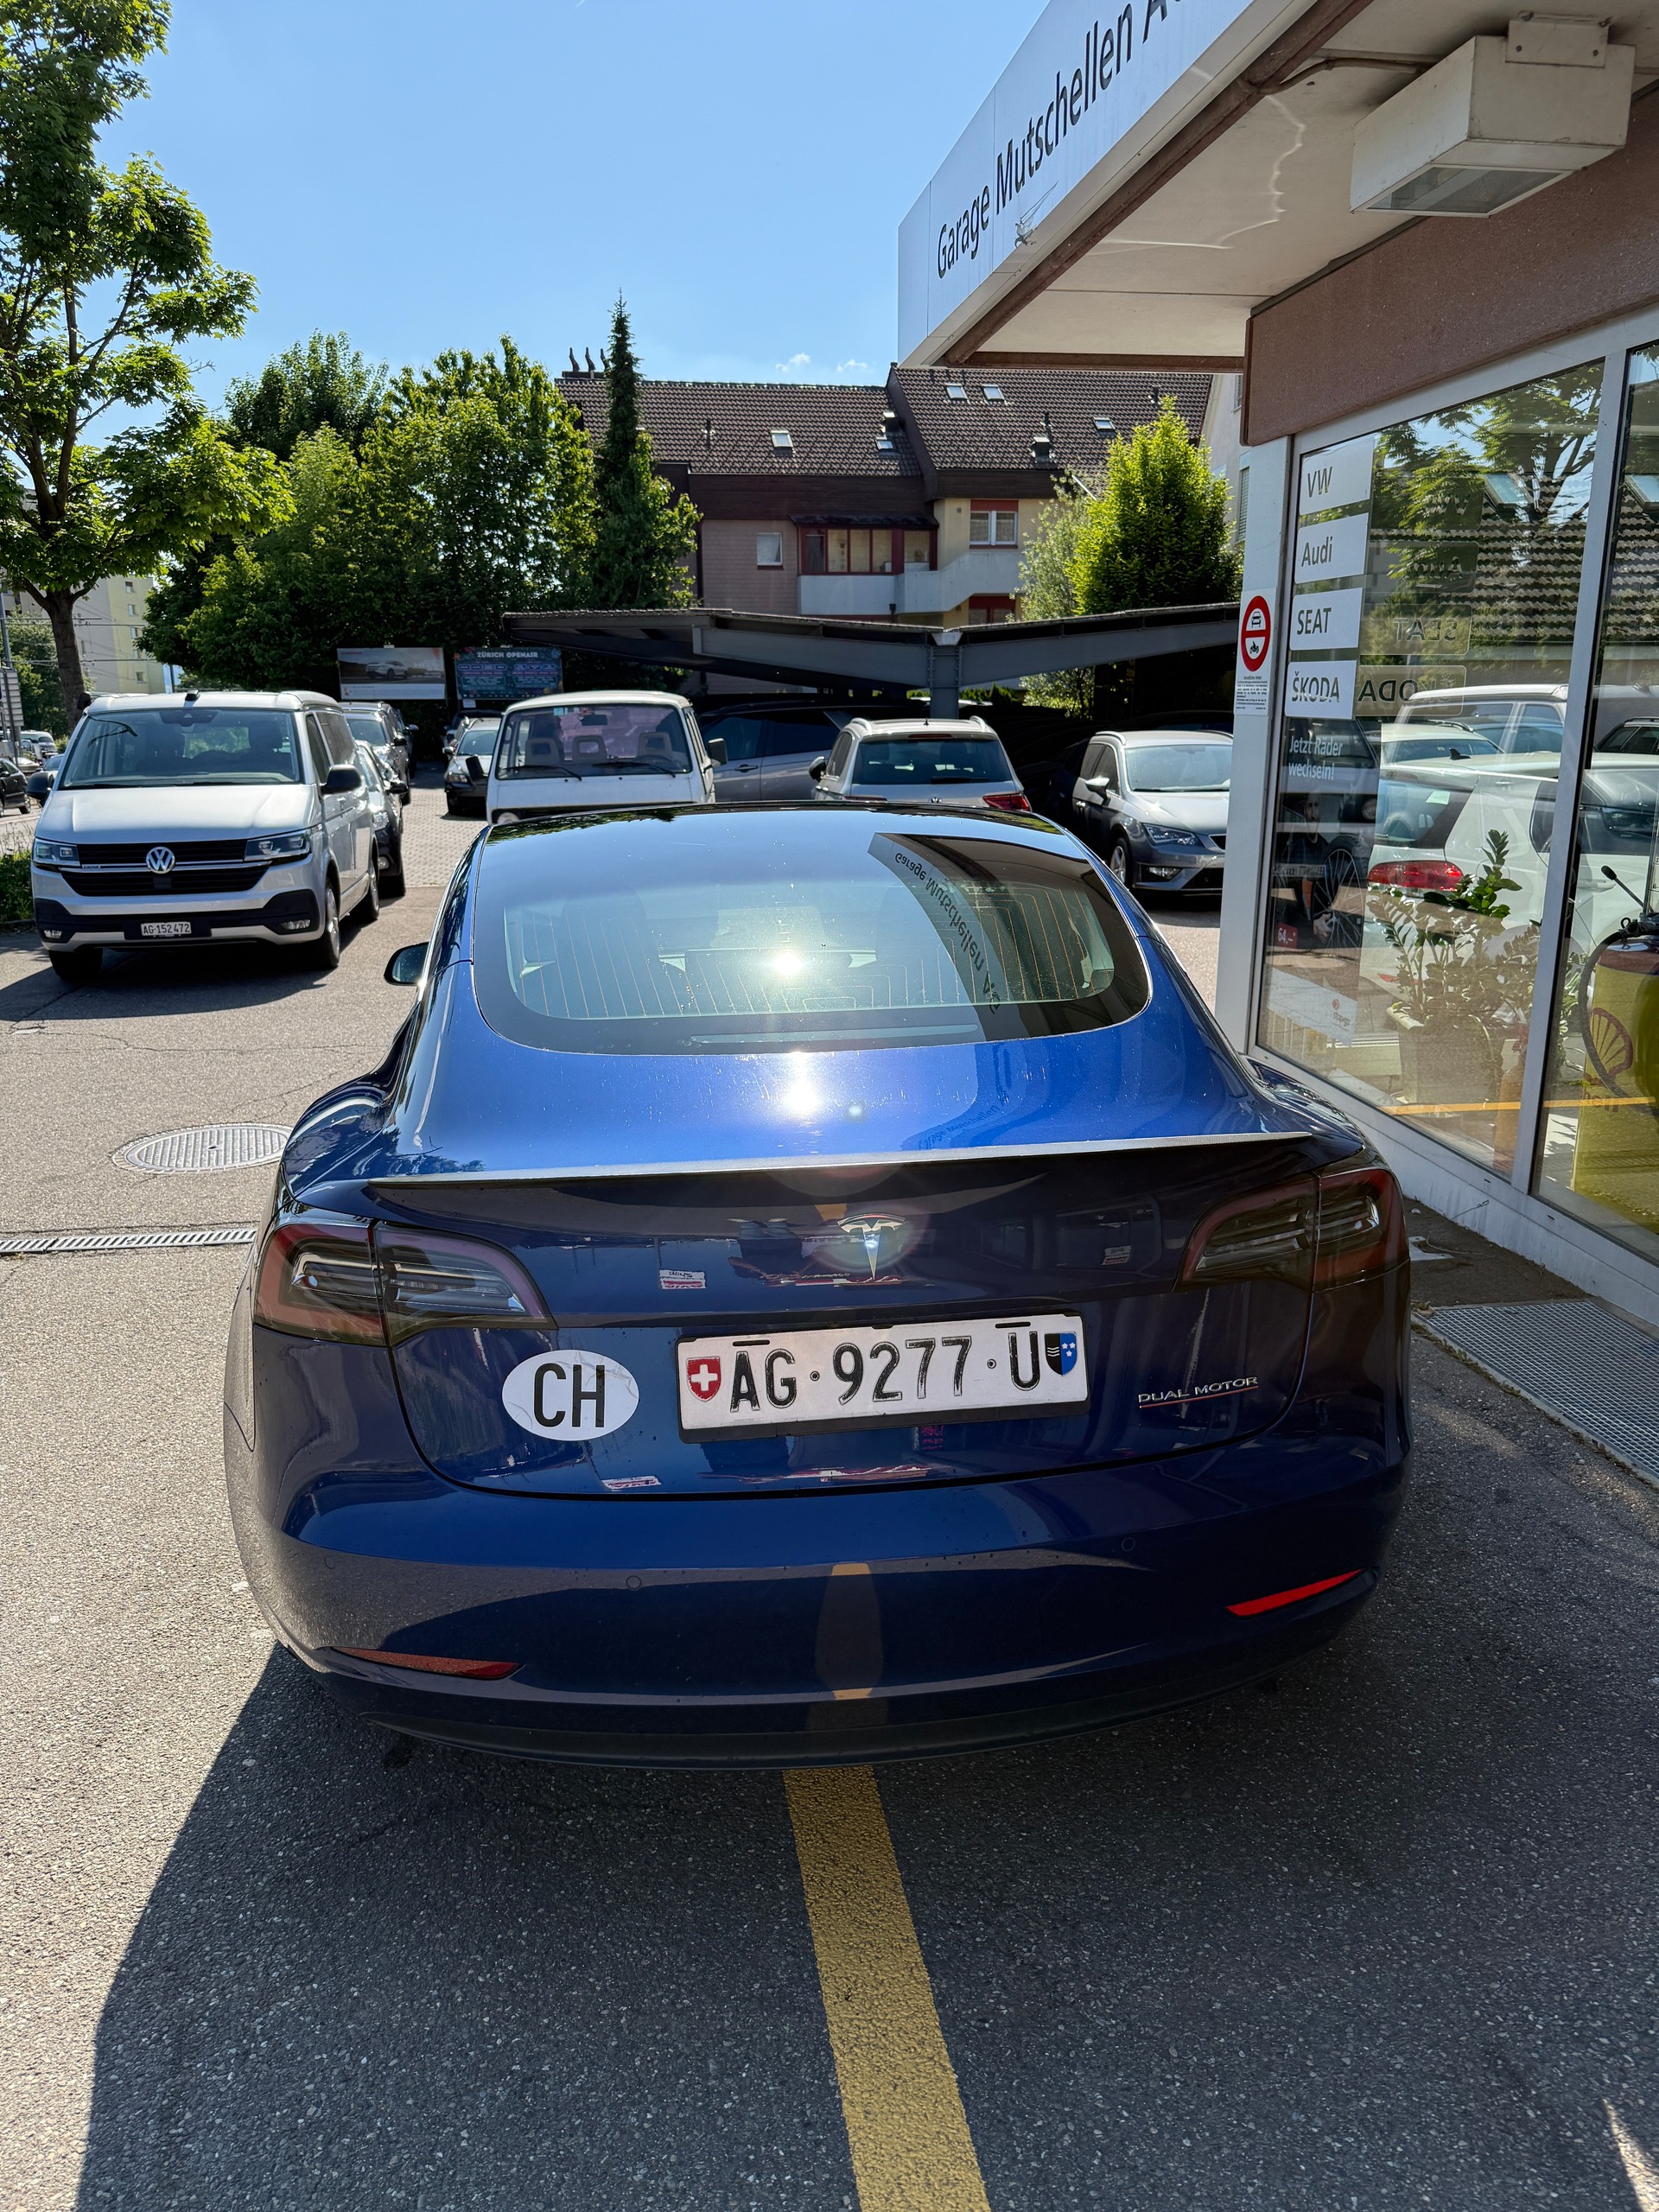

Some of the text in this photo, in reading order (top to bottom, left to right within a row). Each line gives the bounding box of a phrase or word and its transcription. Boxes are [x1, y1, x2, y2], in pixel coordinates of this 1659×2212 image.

[938, 185, 989, 278] Garage
[996, 3, 1133, 215] Mutschellen
[1307, 466, 1332, 498] VW
[1301, 536, 1332, 567] Audi
[1297, 607, 1332, 635] SEAT
[1292, 671, 1339, 702] ŠKODA
[1289, 735, 1343, 756] Jetzt Räder
[1288, 760, 1335, 780] wechseln!
[533, 1362, 606, 1429] CH
[1138, 1376, 1258, 1402] DUAL MOTOR
